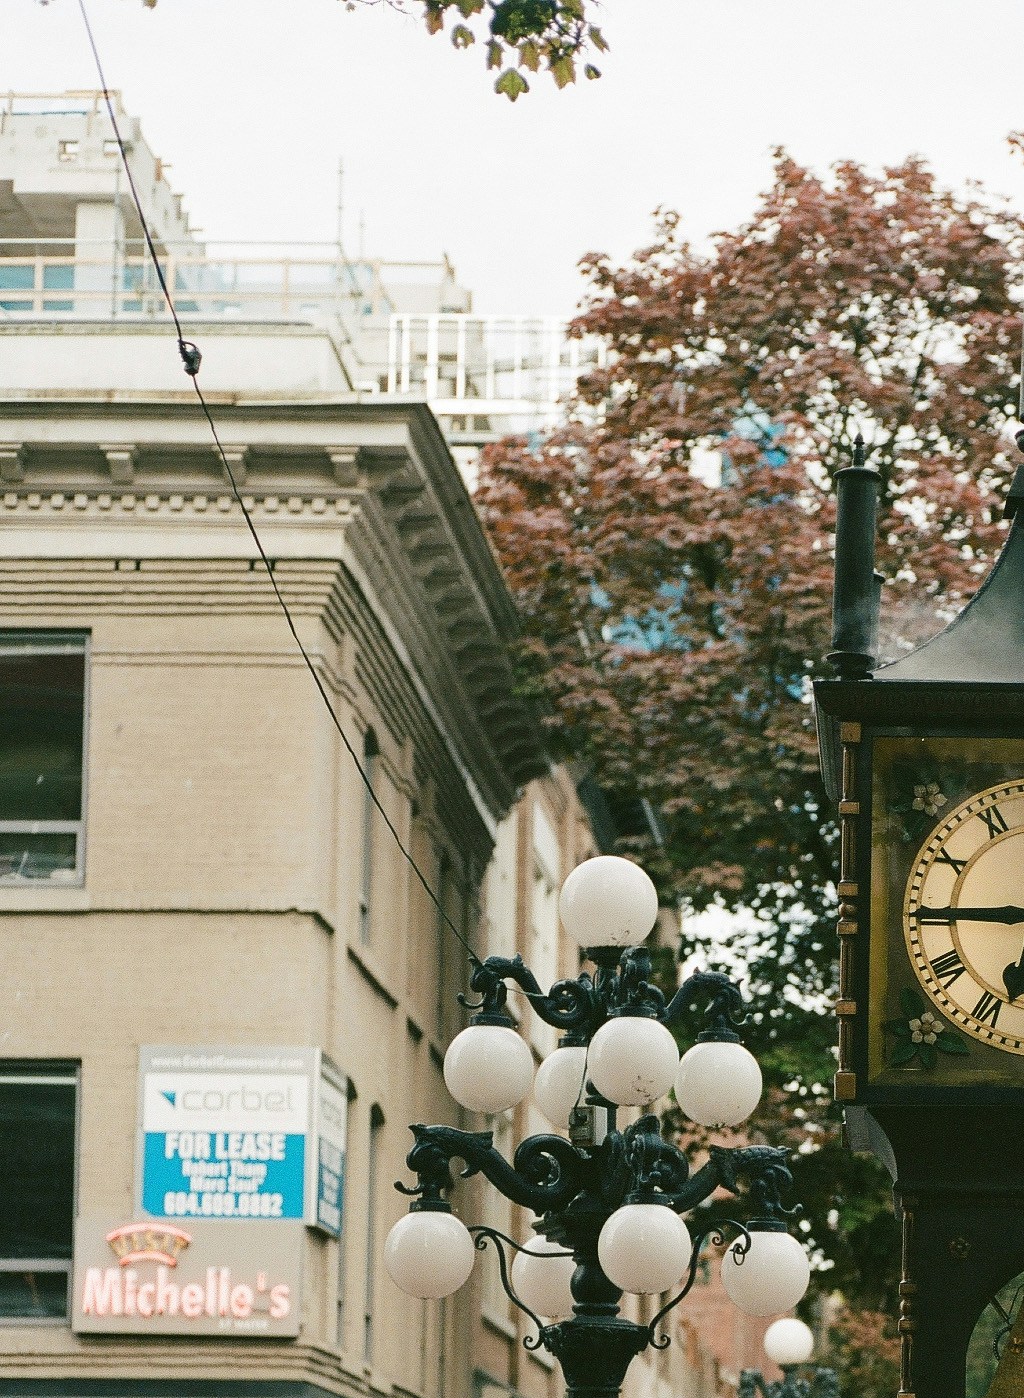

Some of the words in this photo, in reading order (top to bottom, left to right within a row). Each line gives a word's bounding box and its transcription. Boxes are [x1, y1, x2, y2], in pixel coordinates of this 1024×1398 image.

[977, 805, 1009, 838] XI
[934, 847, 969, 876] X
[183, 1086, 293, 1111] corbel
[165, 1132, 211, 1159] FOR
[215, 1132, 286, 1161] LEASE
[82, 1266, 291, 1319] Michelle's
